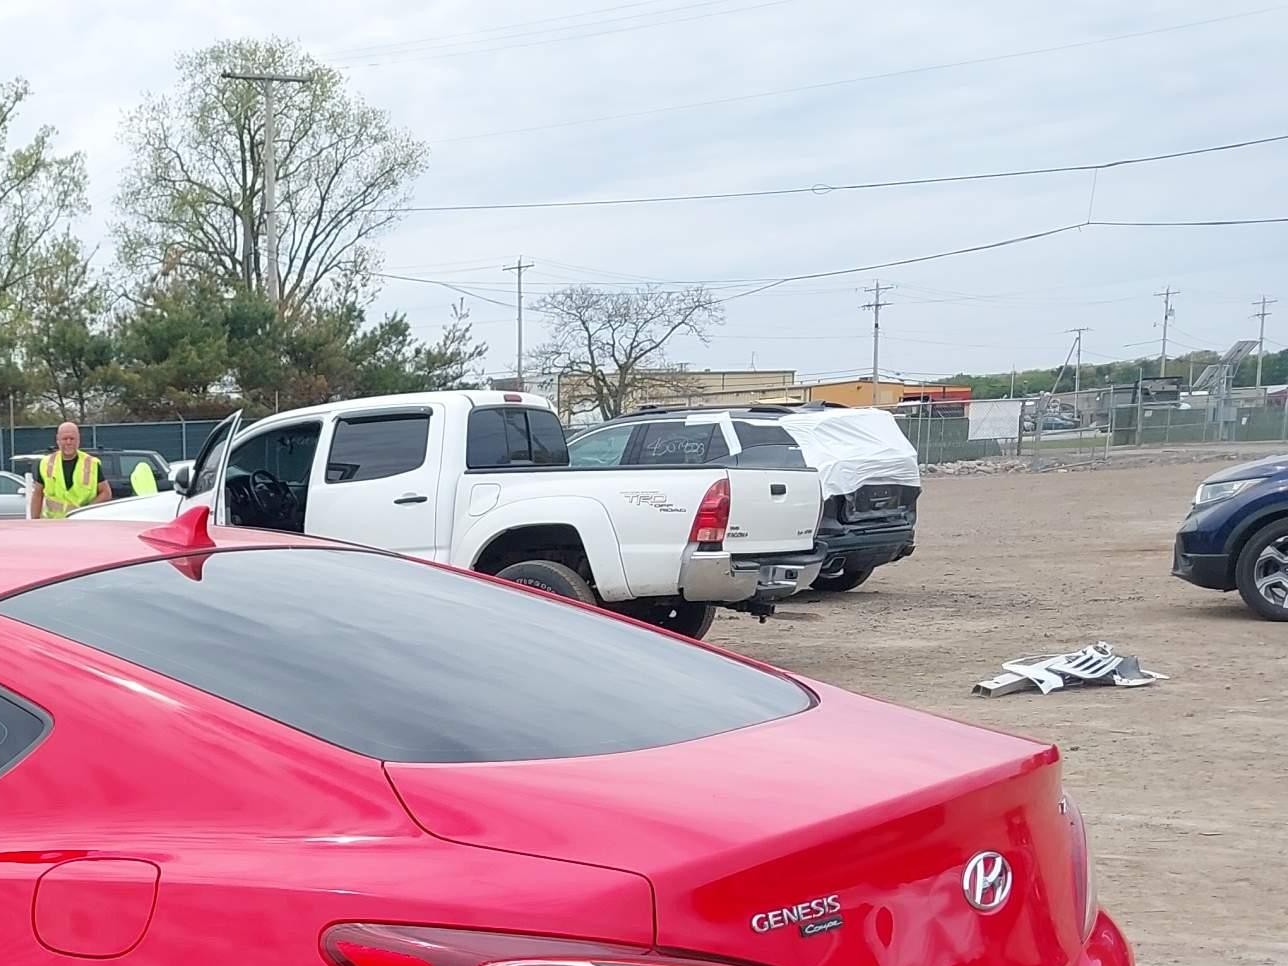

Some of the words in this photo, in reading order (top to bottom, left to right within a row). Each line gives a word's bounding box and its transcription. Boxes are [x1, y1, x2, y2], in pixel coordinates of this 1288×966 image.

[624, 494, 668, 506] TRD
[750, 894, 841, 933] GENESIS
[804, 918, 844, 935] Coupe
